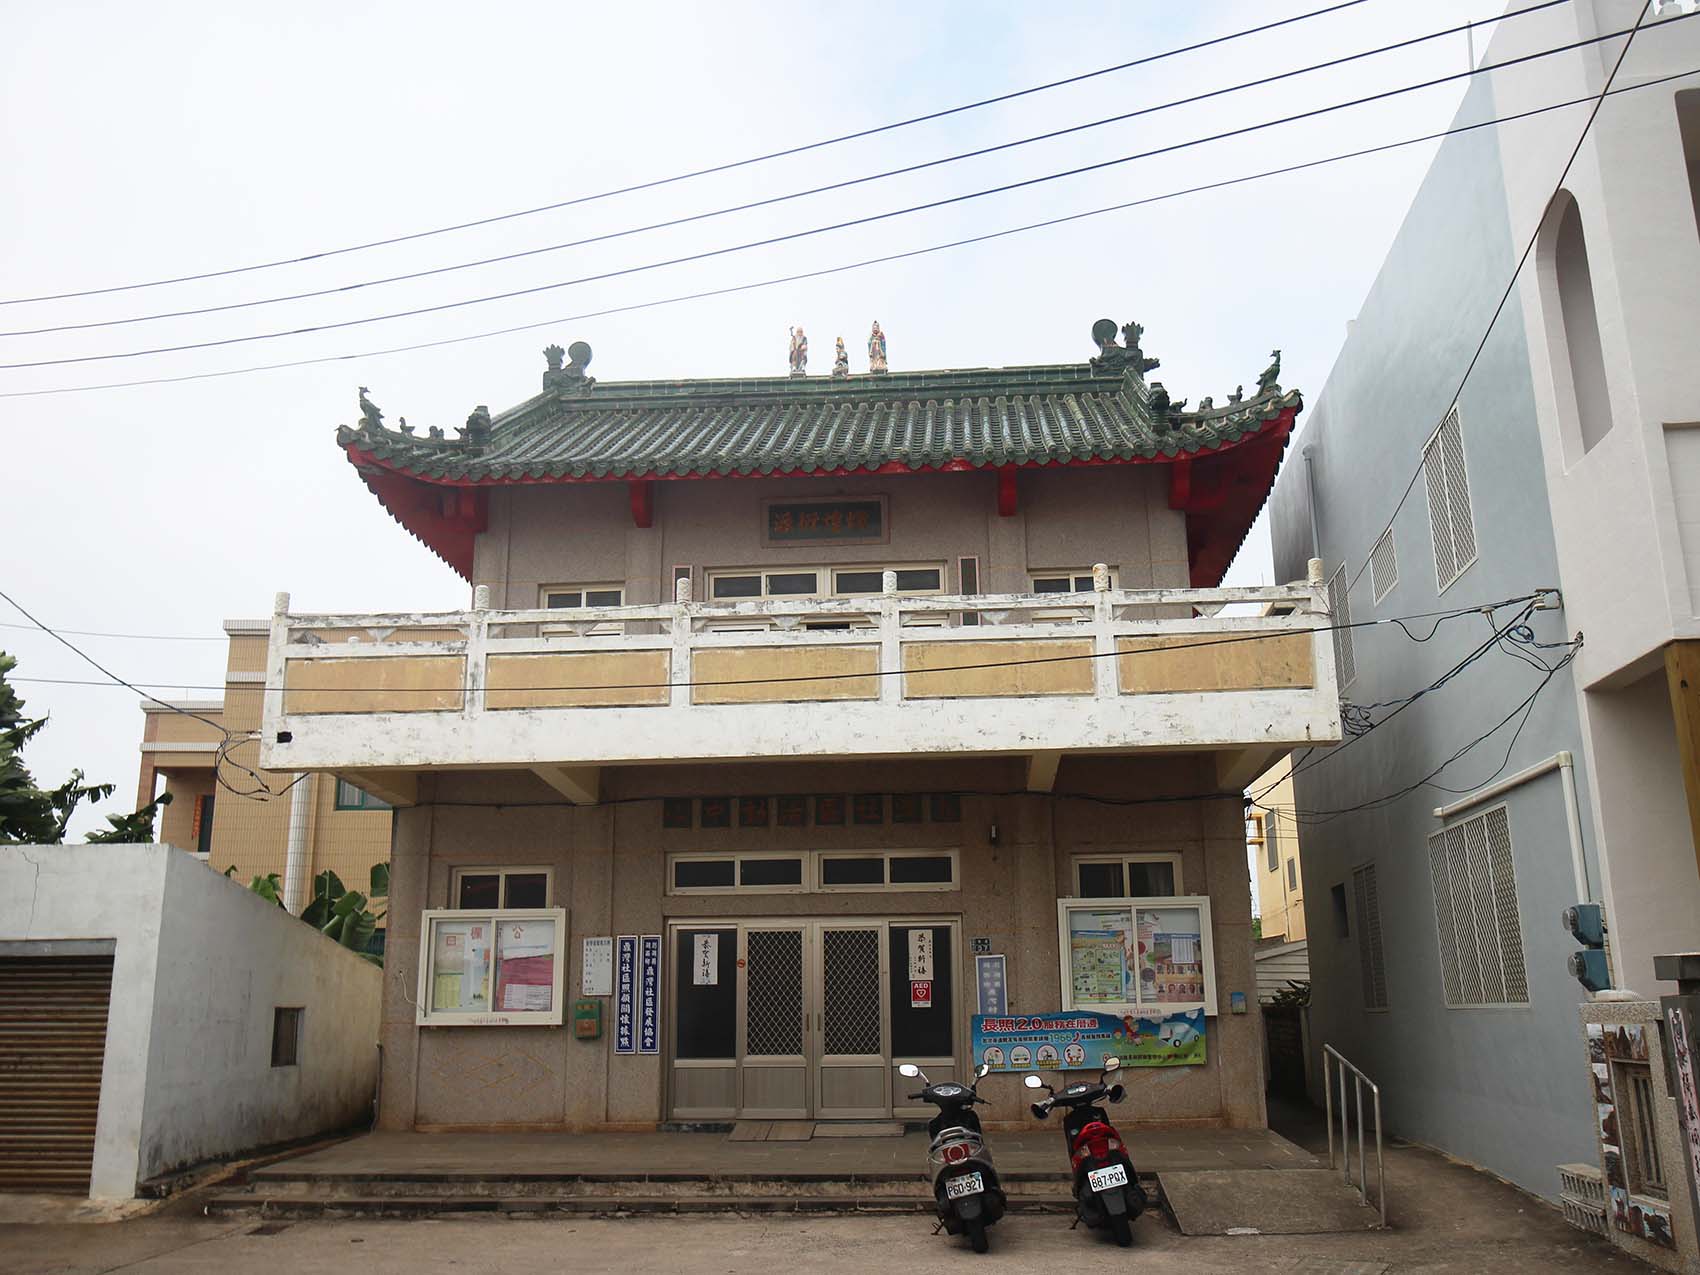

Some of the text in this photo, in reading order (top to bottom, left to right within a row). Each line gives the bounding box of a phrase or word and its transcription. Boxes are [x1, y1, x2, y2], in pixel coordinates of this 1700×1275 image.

[1049, 1032, 1072, 1043] 1966
[948, 1179, 981, 1197] P6D-927
[1091, 1171, 1126, 1188] 887-PQX
